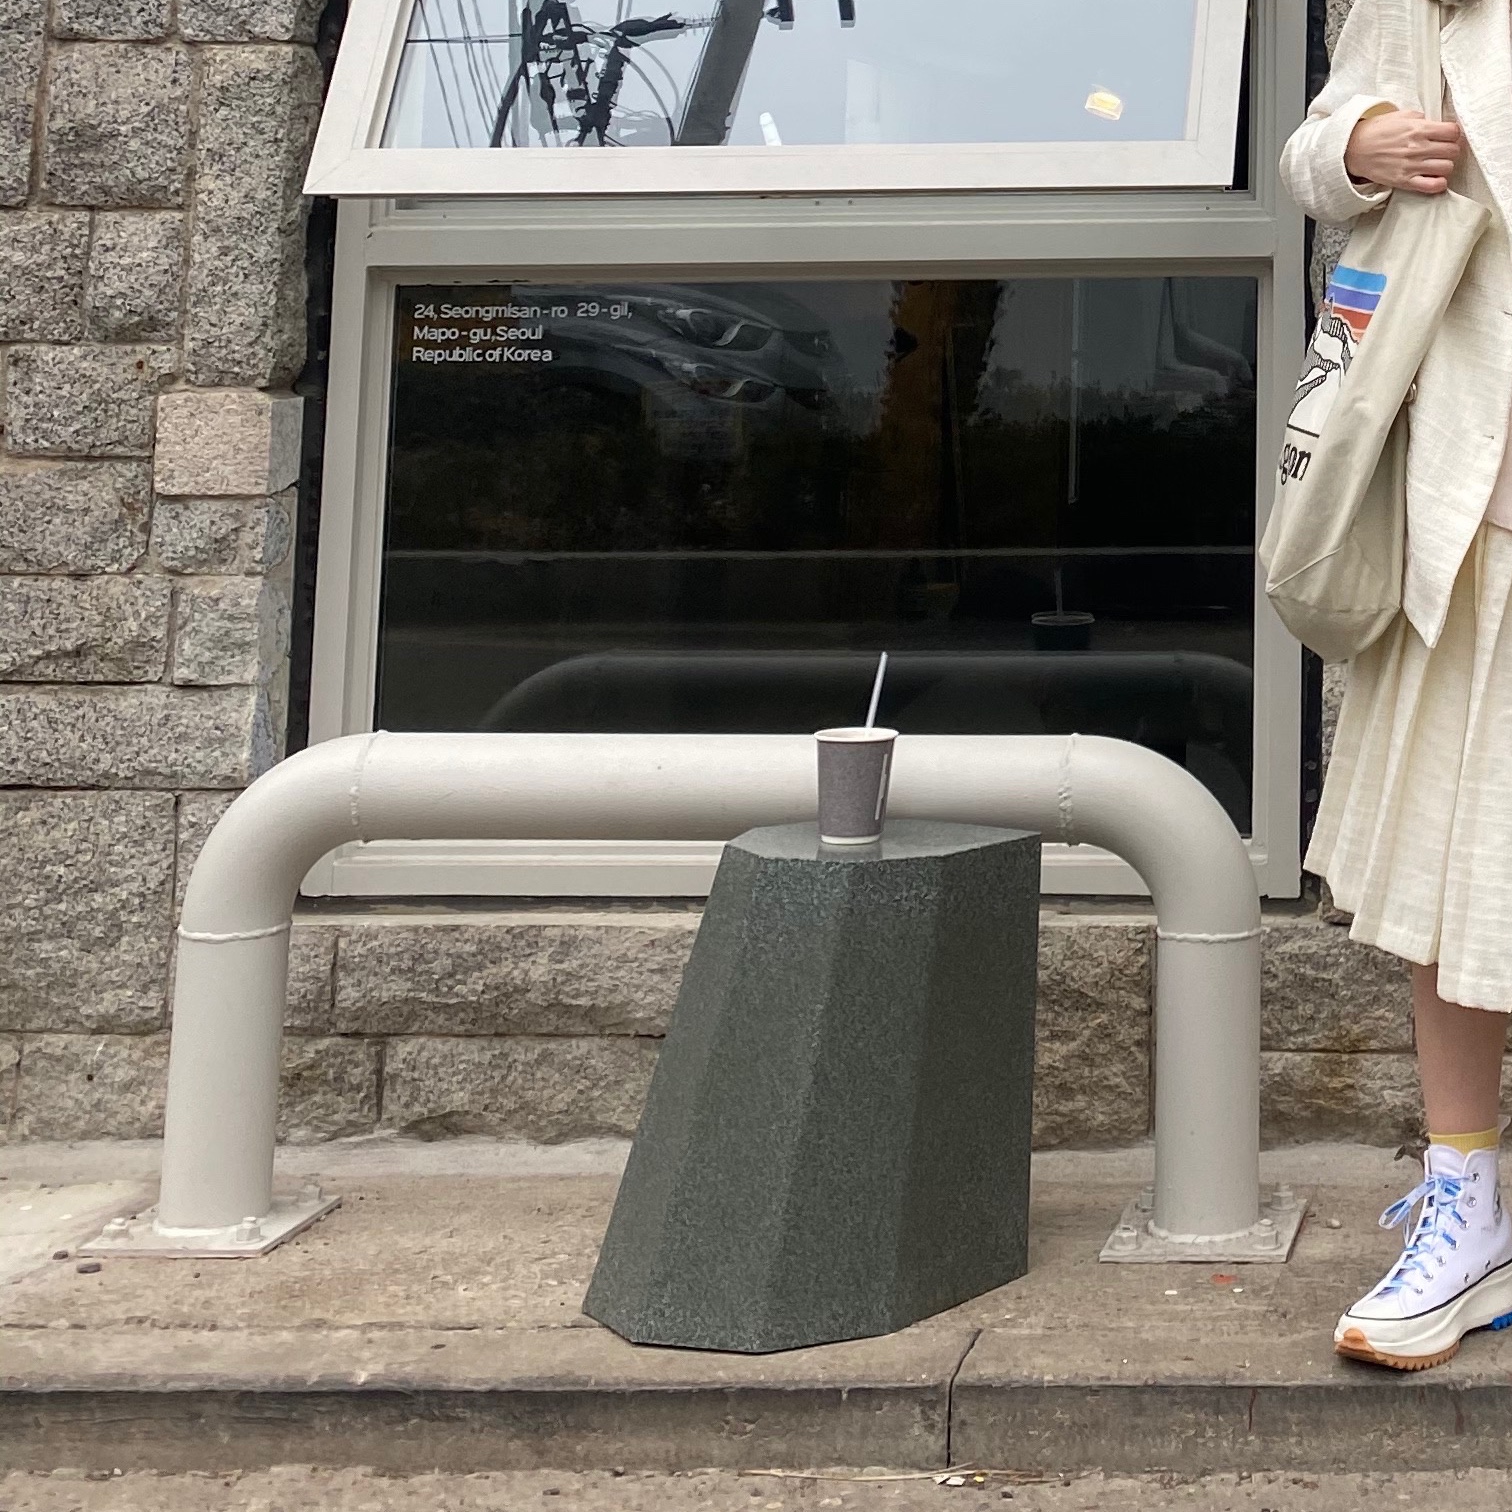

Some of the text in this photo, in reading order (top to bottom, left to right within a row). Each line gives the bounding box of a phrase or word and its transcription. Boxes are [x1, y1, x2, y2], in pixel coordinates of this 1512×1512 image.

[576, 301, 633, 320] 29-gil,
[412, 346, 553, 365] Republic of Korea
[1278, 442, 1312, 485] gon
